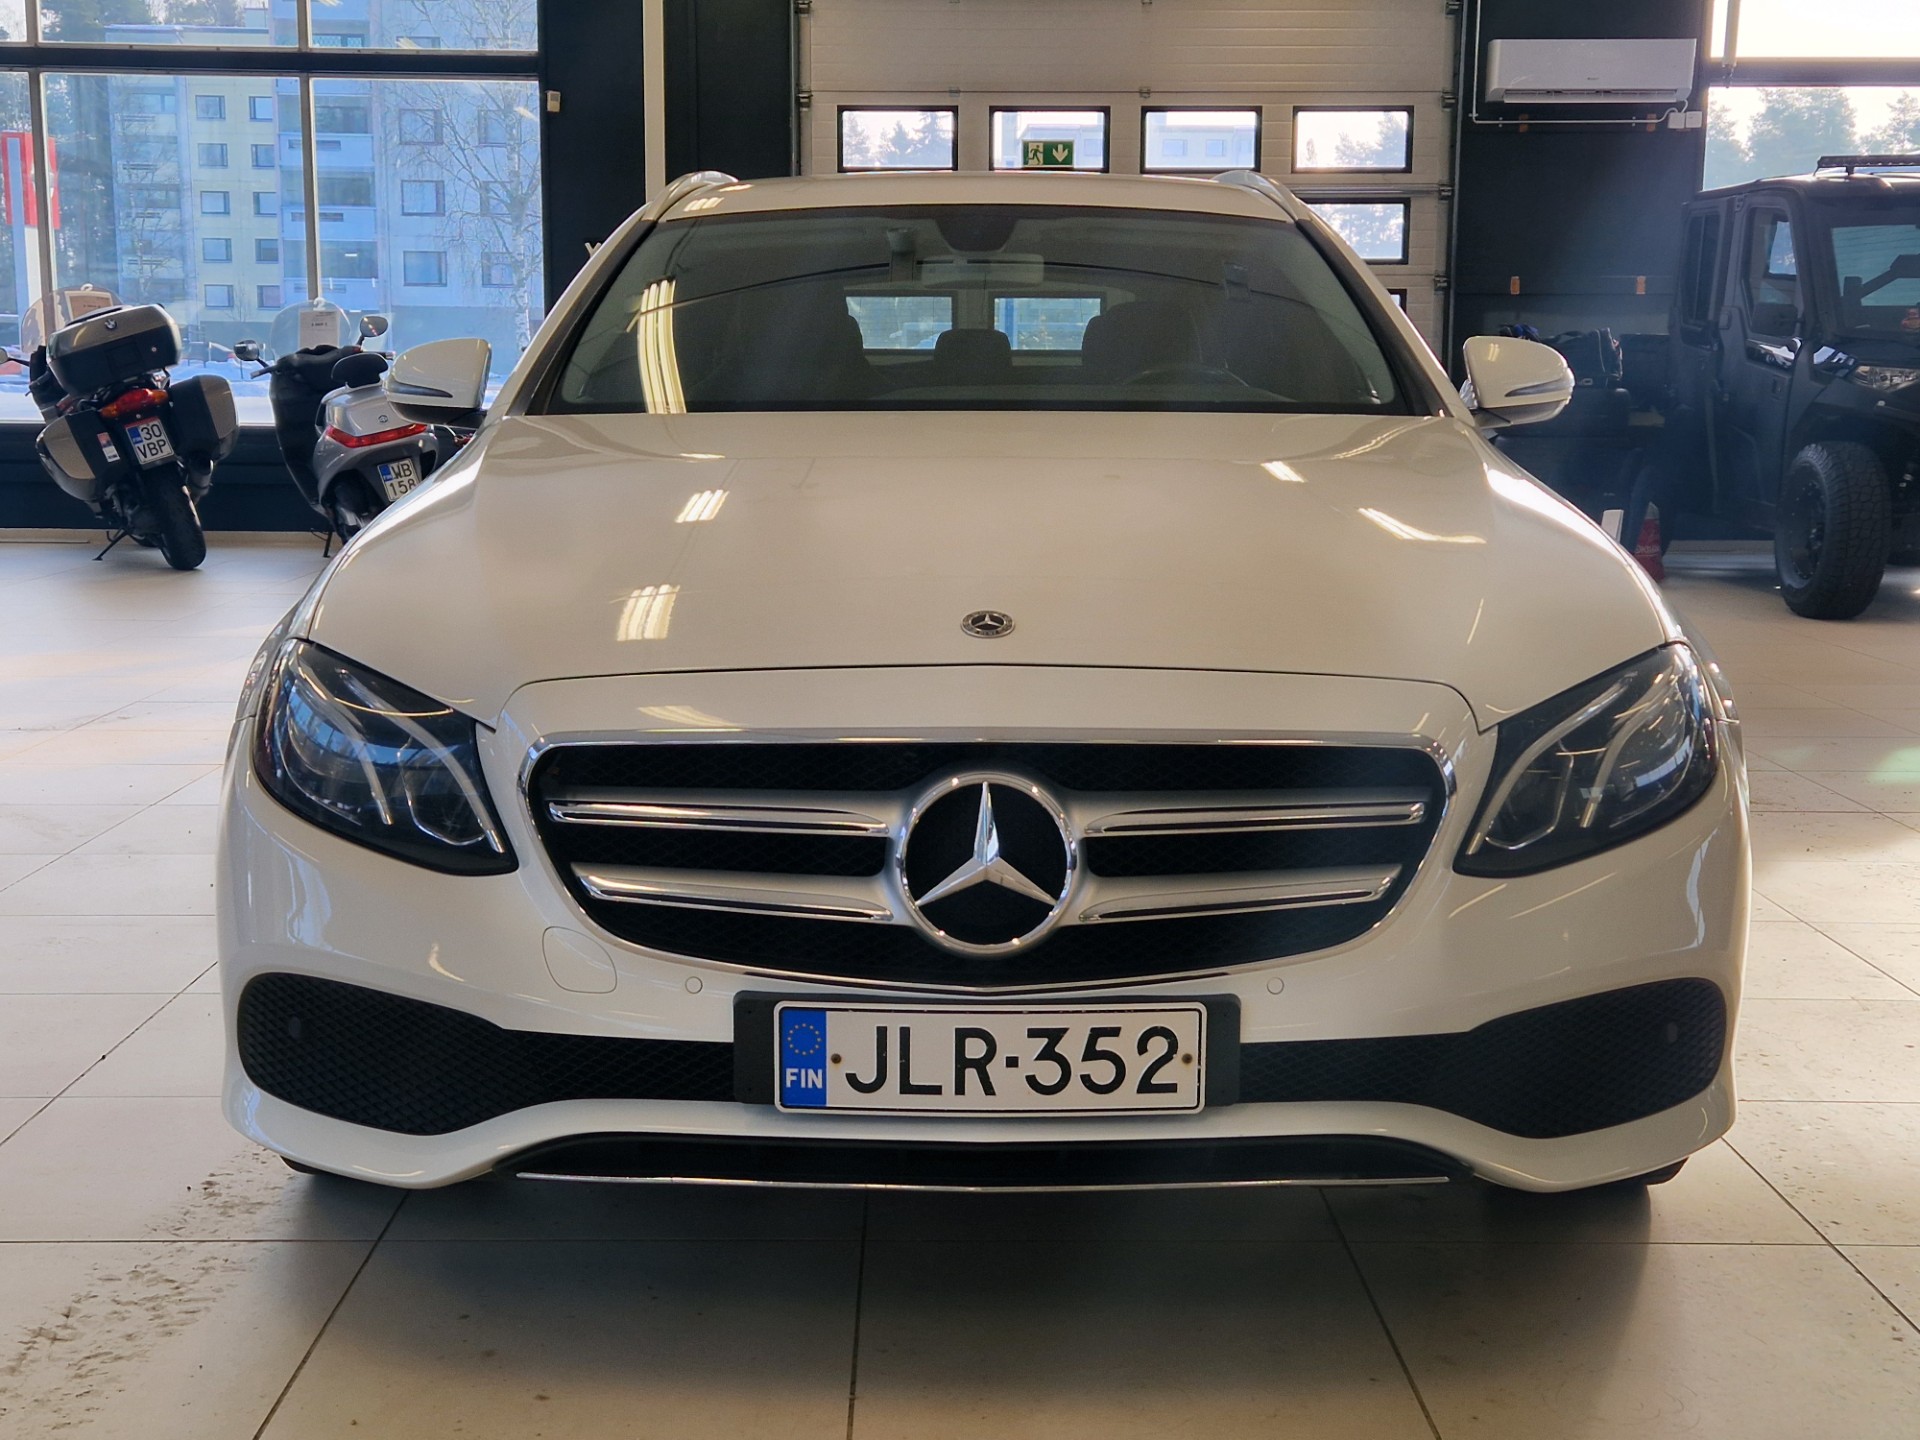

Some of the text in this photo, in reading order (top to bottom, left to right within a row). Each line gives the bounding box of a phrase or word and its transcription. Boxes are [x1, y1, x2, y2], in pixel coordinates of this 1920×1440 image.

[141, 424, 162, 441] 30
[136, 439, 166, 459] VBP
[391, 463, 412, 479] WB
[845, 1025, 1179, 1096] JLR-352
[785, 1067, 823, 1089] FIN
